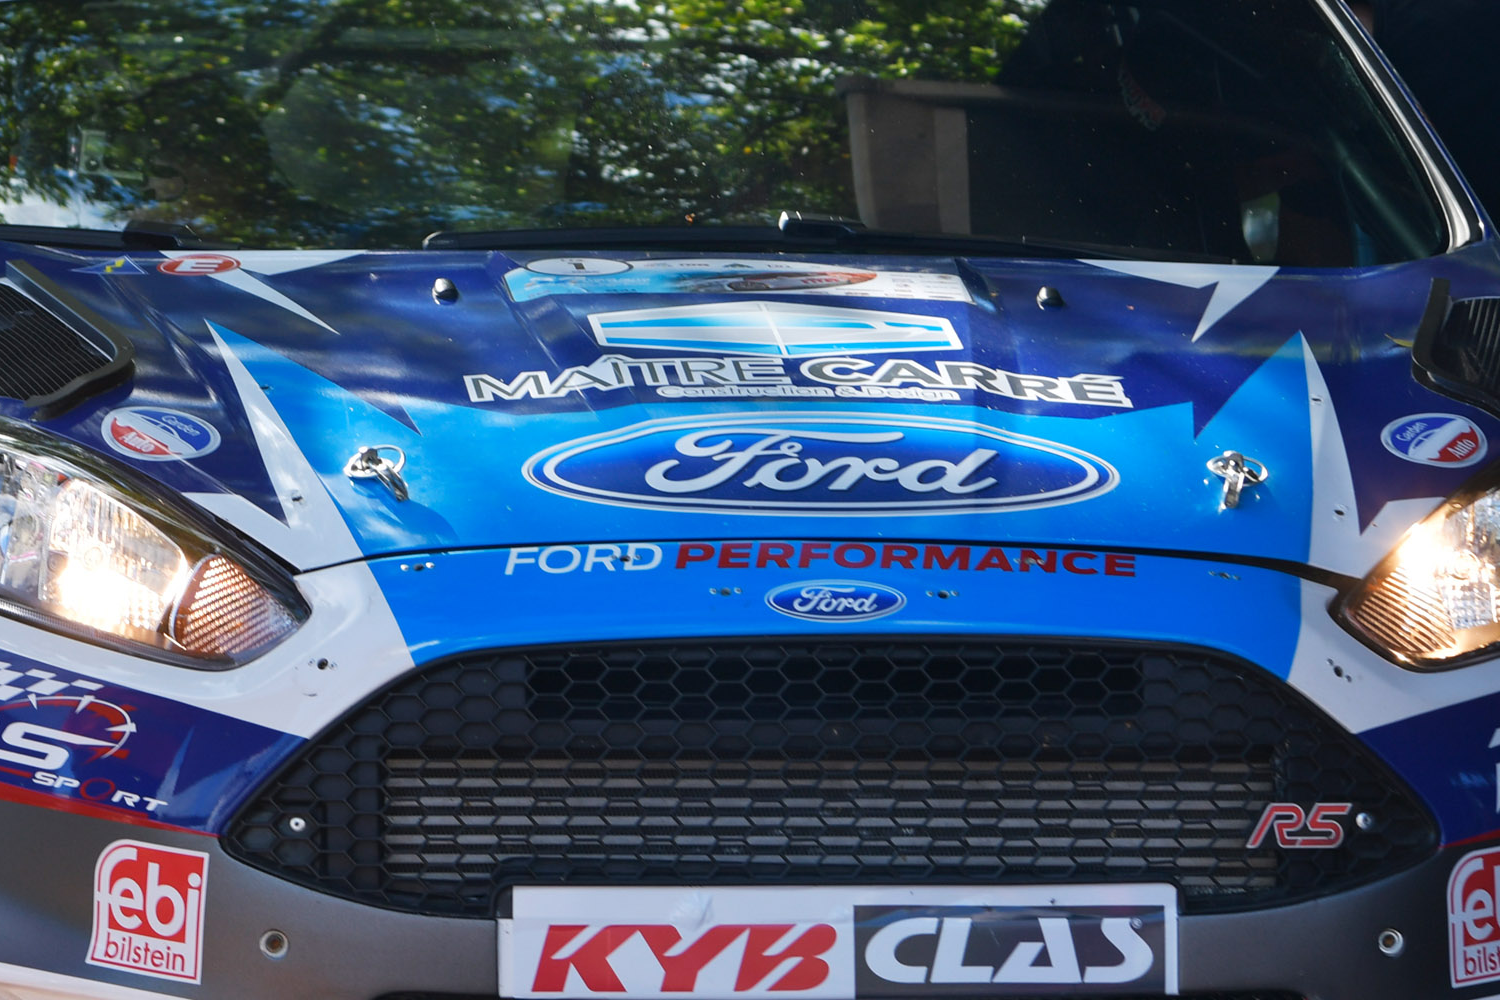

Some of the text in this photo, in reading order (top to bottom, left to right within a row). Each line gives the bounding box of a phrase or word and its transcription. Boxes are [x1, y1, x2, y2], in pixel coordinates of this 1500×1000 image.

[463, 354, 1134, 408] MAÎTRE CARRÉ
[656, 385, 961, 401] Construction & Design
[643, 426, 1000, 496] Ford
[504, 543, 1138, 578] FORD PERFORMANCE
[792, 586, 878, 612] Ford
[31, 770, 169, 811] SPORT
[96, 843, 203, 944] febi
[1451, 857, 1500, 942] fe
[102, 929, 187, 974] bilstein
[531, 917, 1156, 992] KYB CLAS
